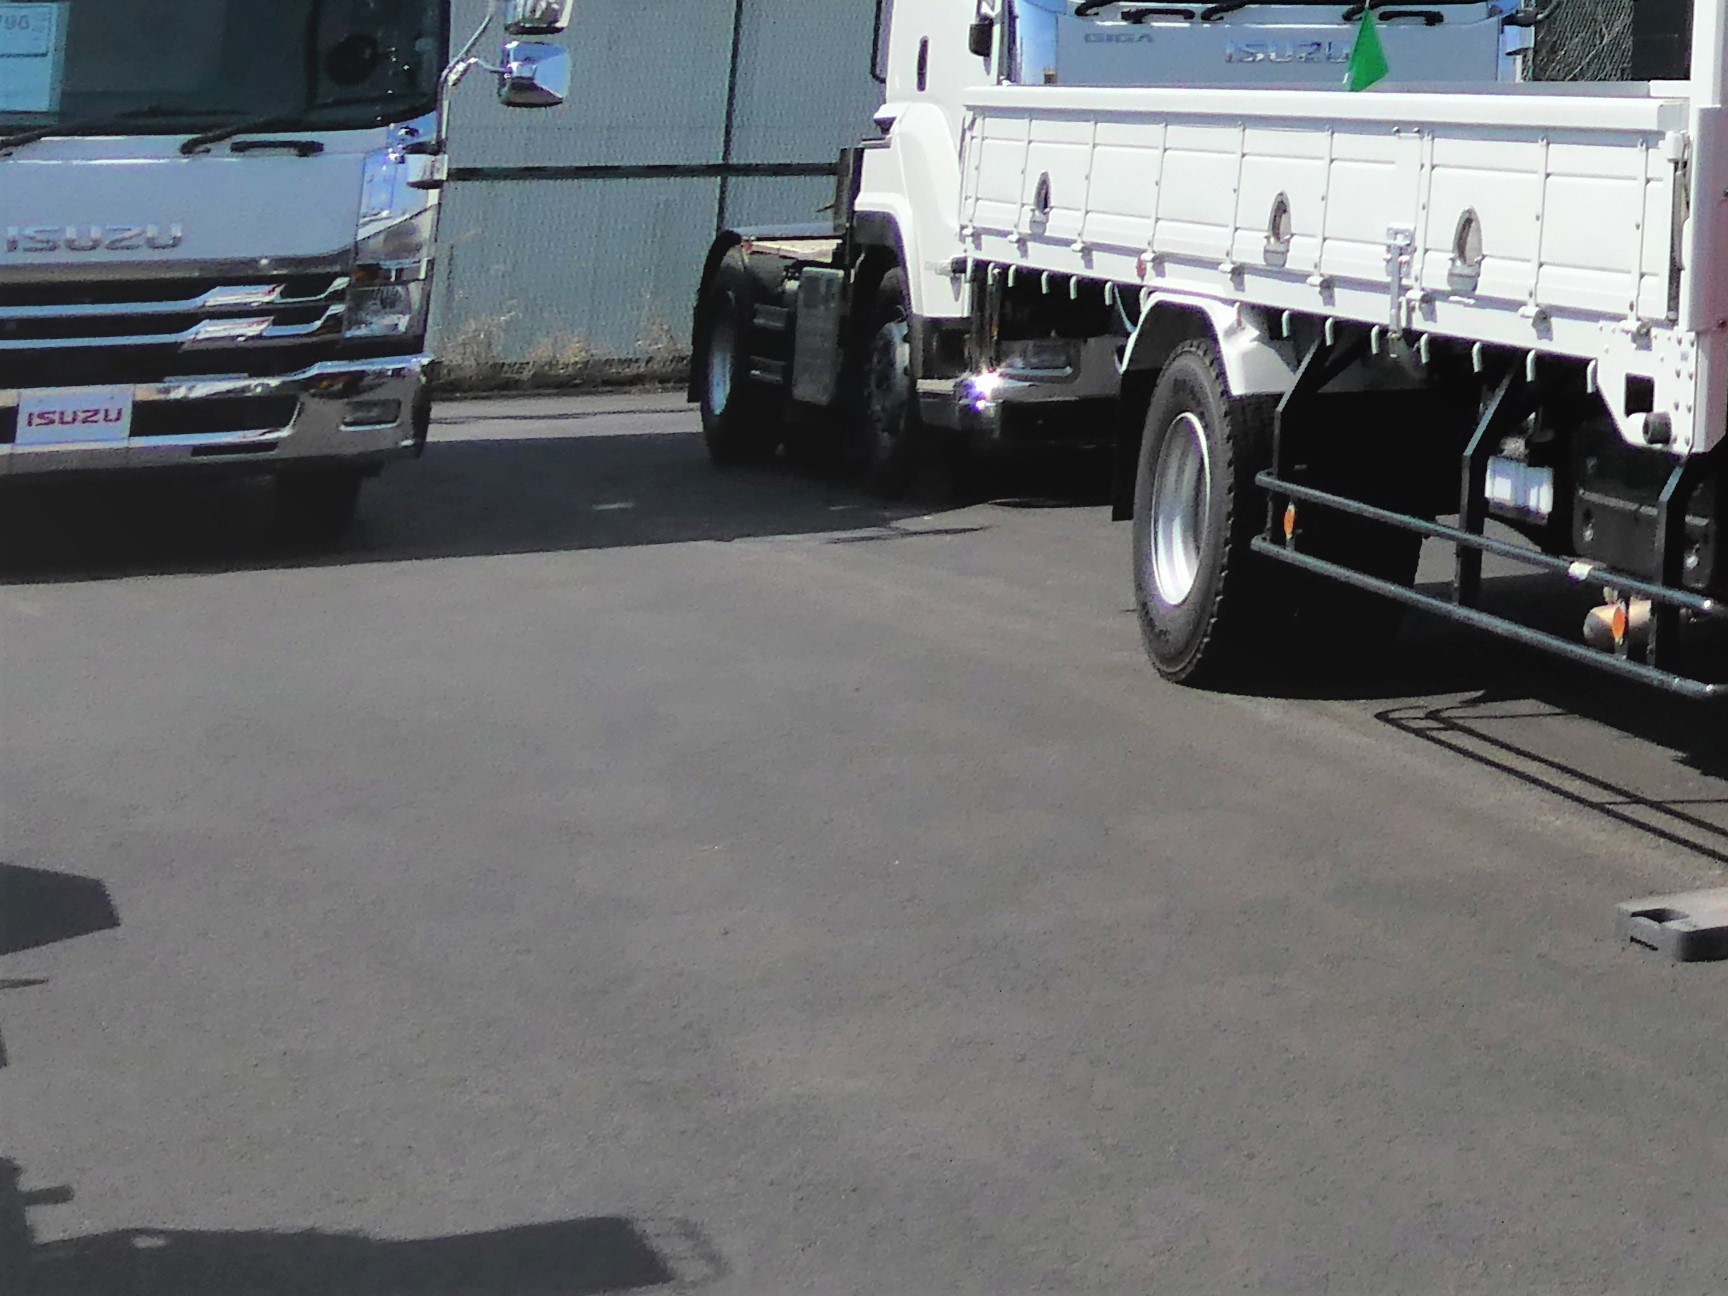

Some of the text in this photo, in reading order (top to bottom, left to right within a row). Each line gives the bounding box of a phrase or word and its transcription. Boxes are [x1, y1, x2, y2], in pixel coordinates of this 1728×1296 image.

[1225, 40, 1349, 63] ISUZU
[7, 223, 182, 252] ISUZU
[27, 408, 123, 427] ISUZU
